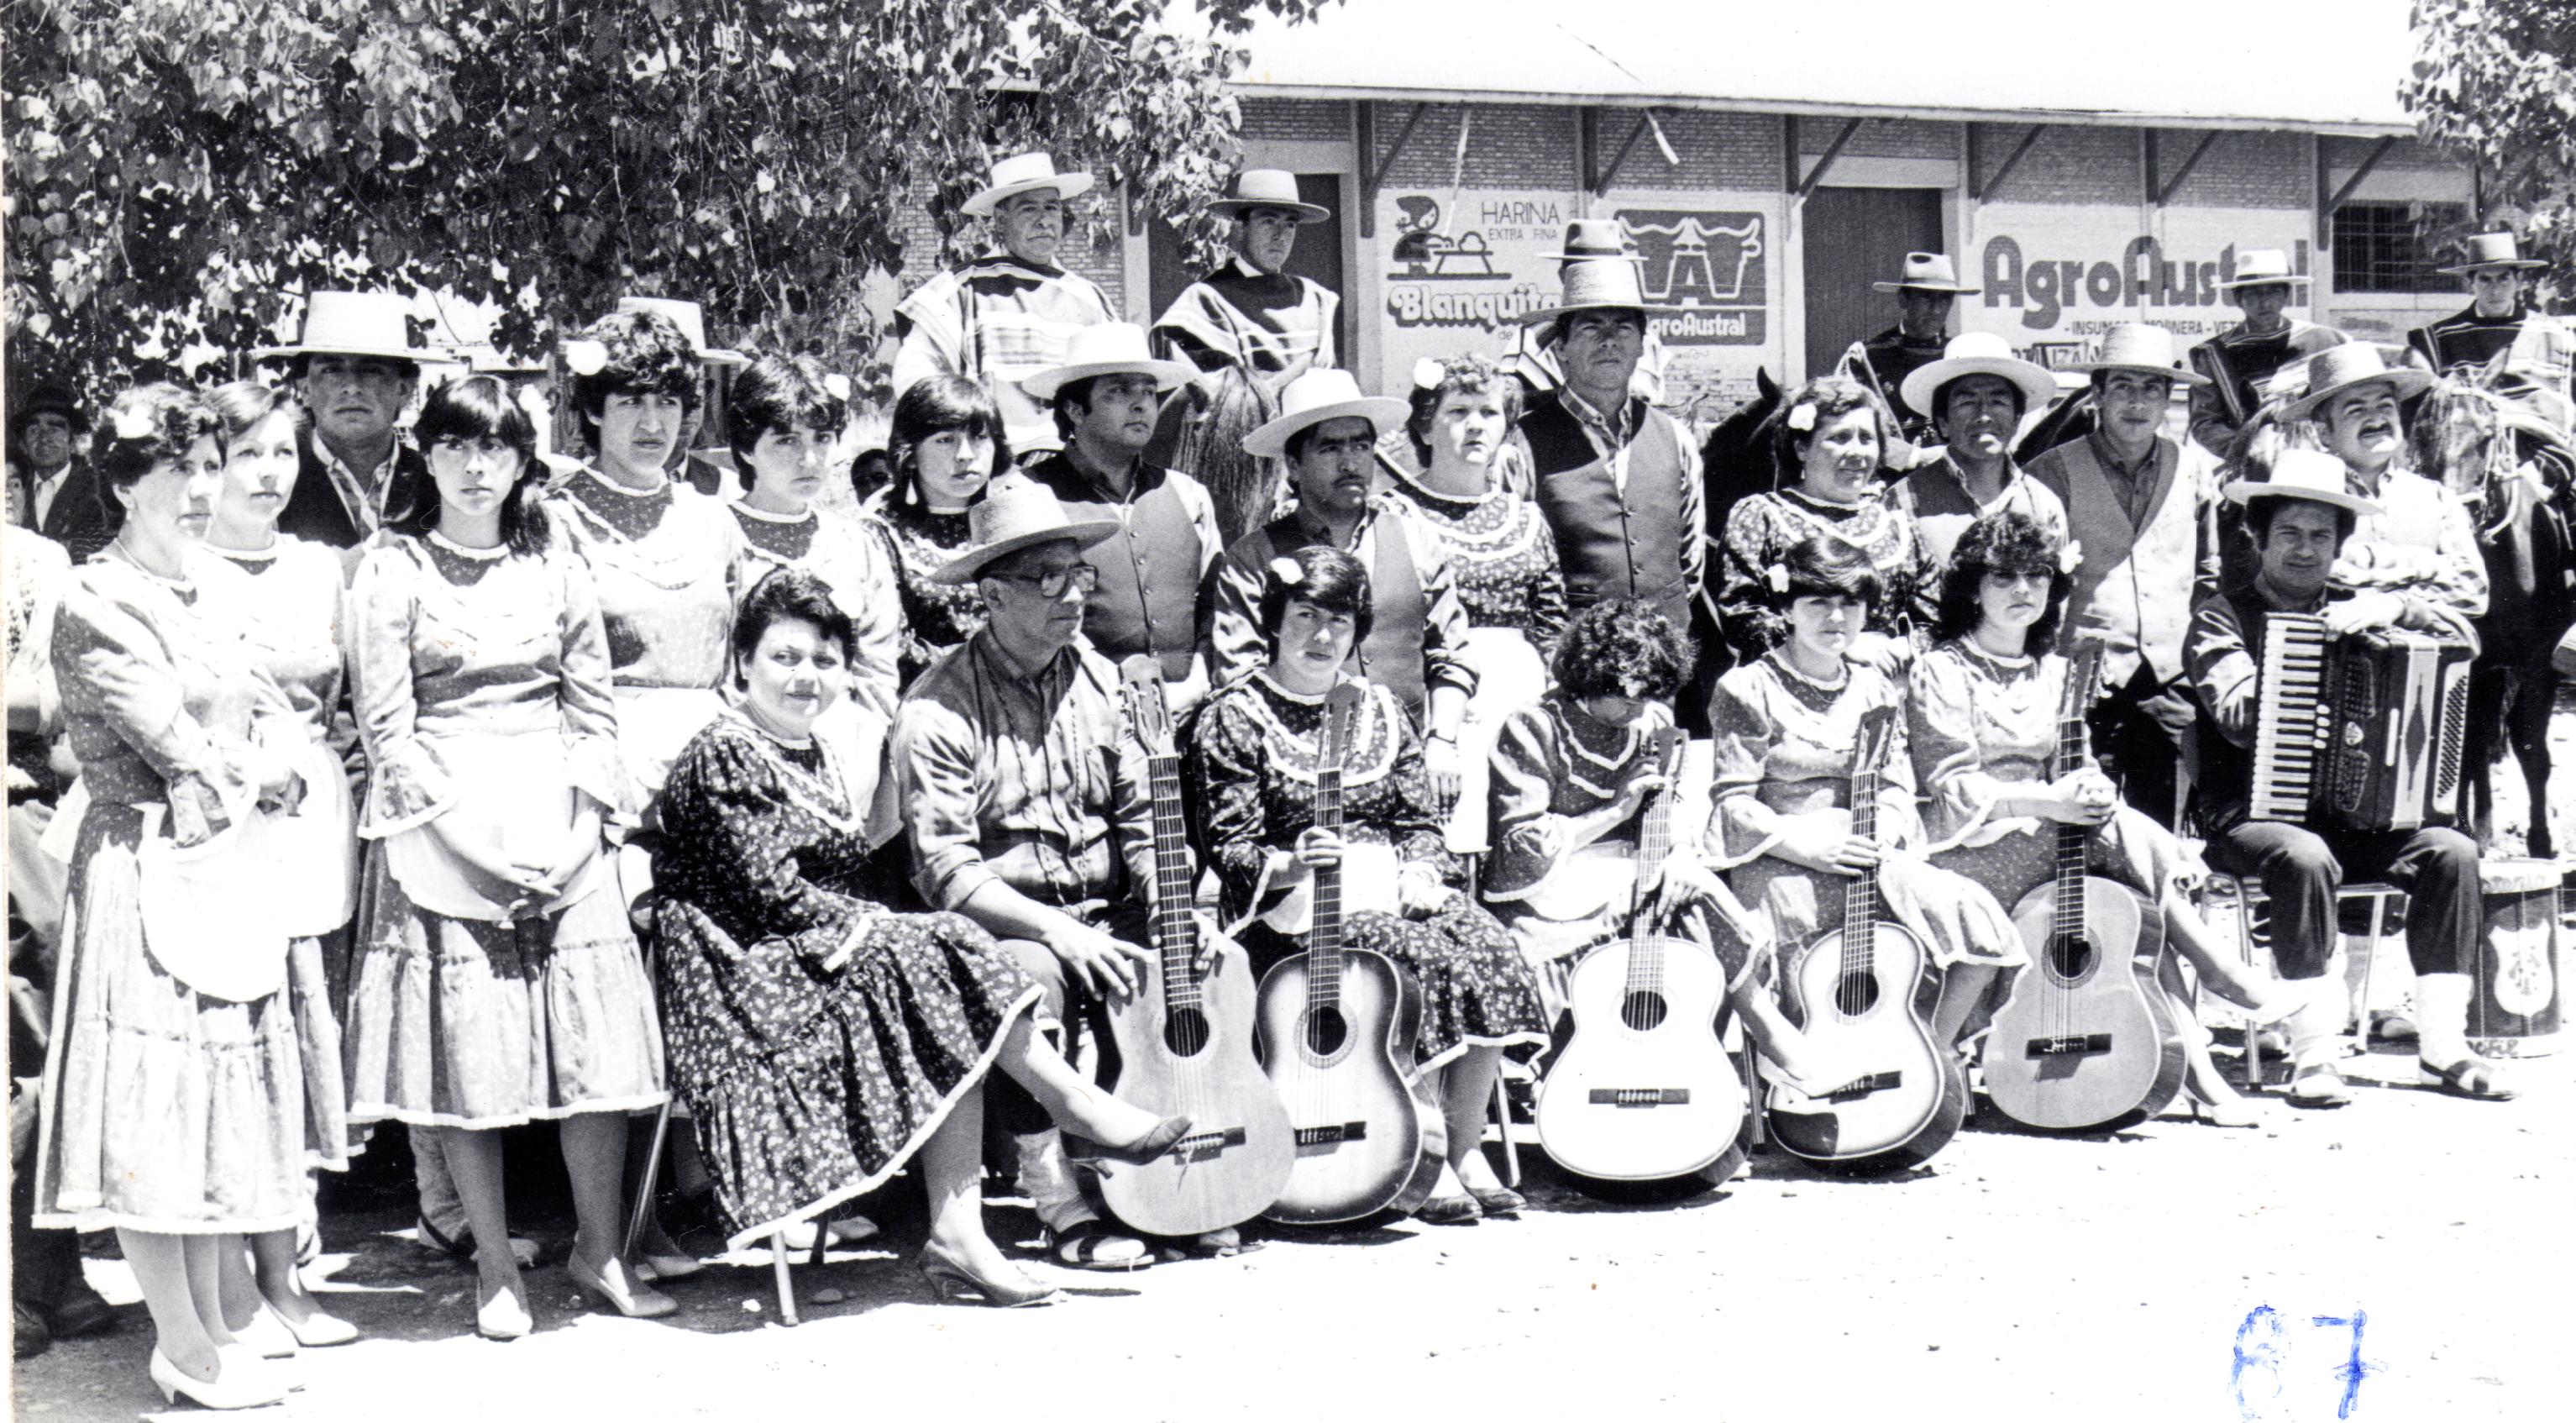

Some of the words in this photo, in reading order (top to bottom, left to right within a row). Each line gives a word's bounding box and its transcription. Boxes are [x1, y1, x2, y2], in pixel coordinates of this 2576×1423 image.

[1481, 201, 1561, 225] HARINA
[1488, 228, 1523, 241] EXTRA
[1533, 228, 1557, 241] FINA
[1983, 234, 2308, 330] AgroAustl
[1388, 283, 1562, 333] Blanquita
[1645, 312, 1746, 337] groAustral
[2072, 320, 2130, 335] INSUM
